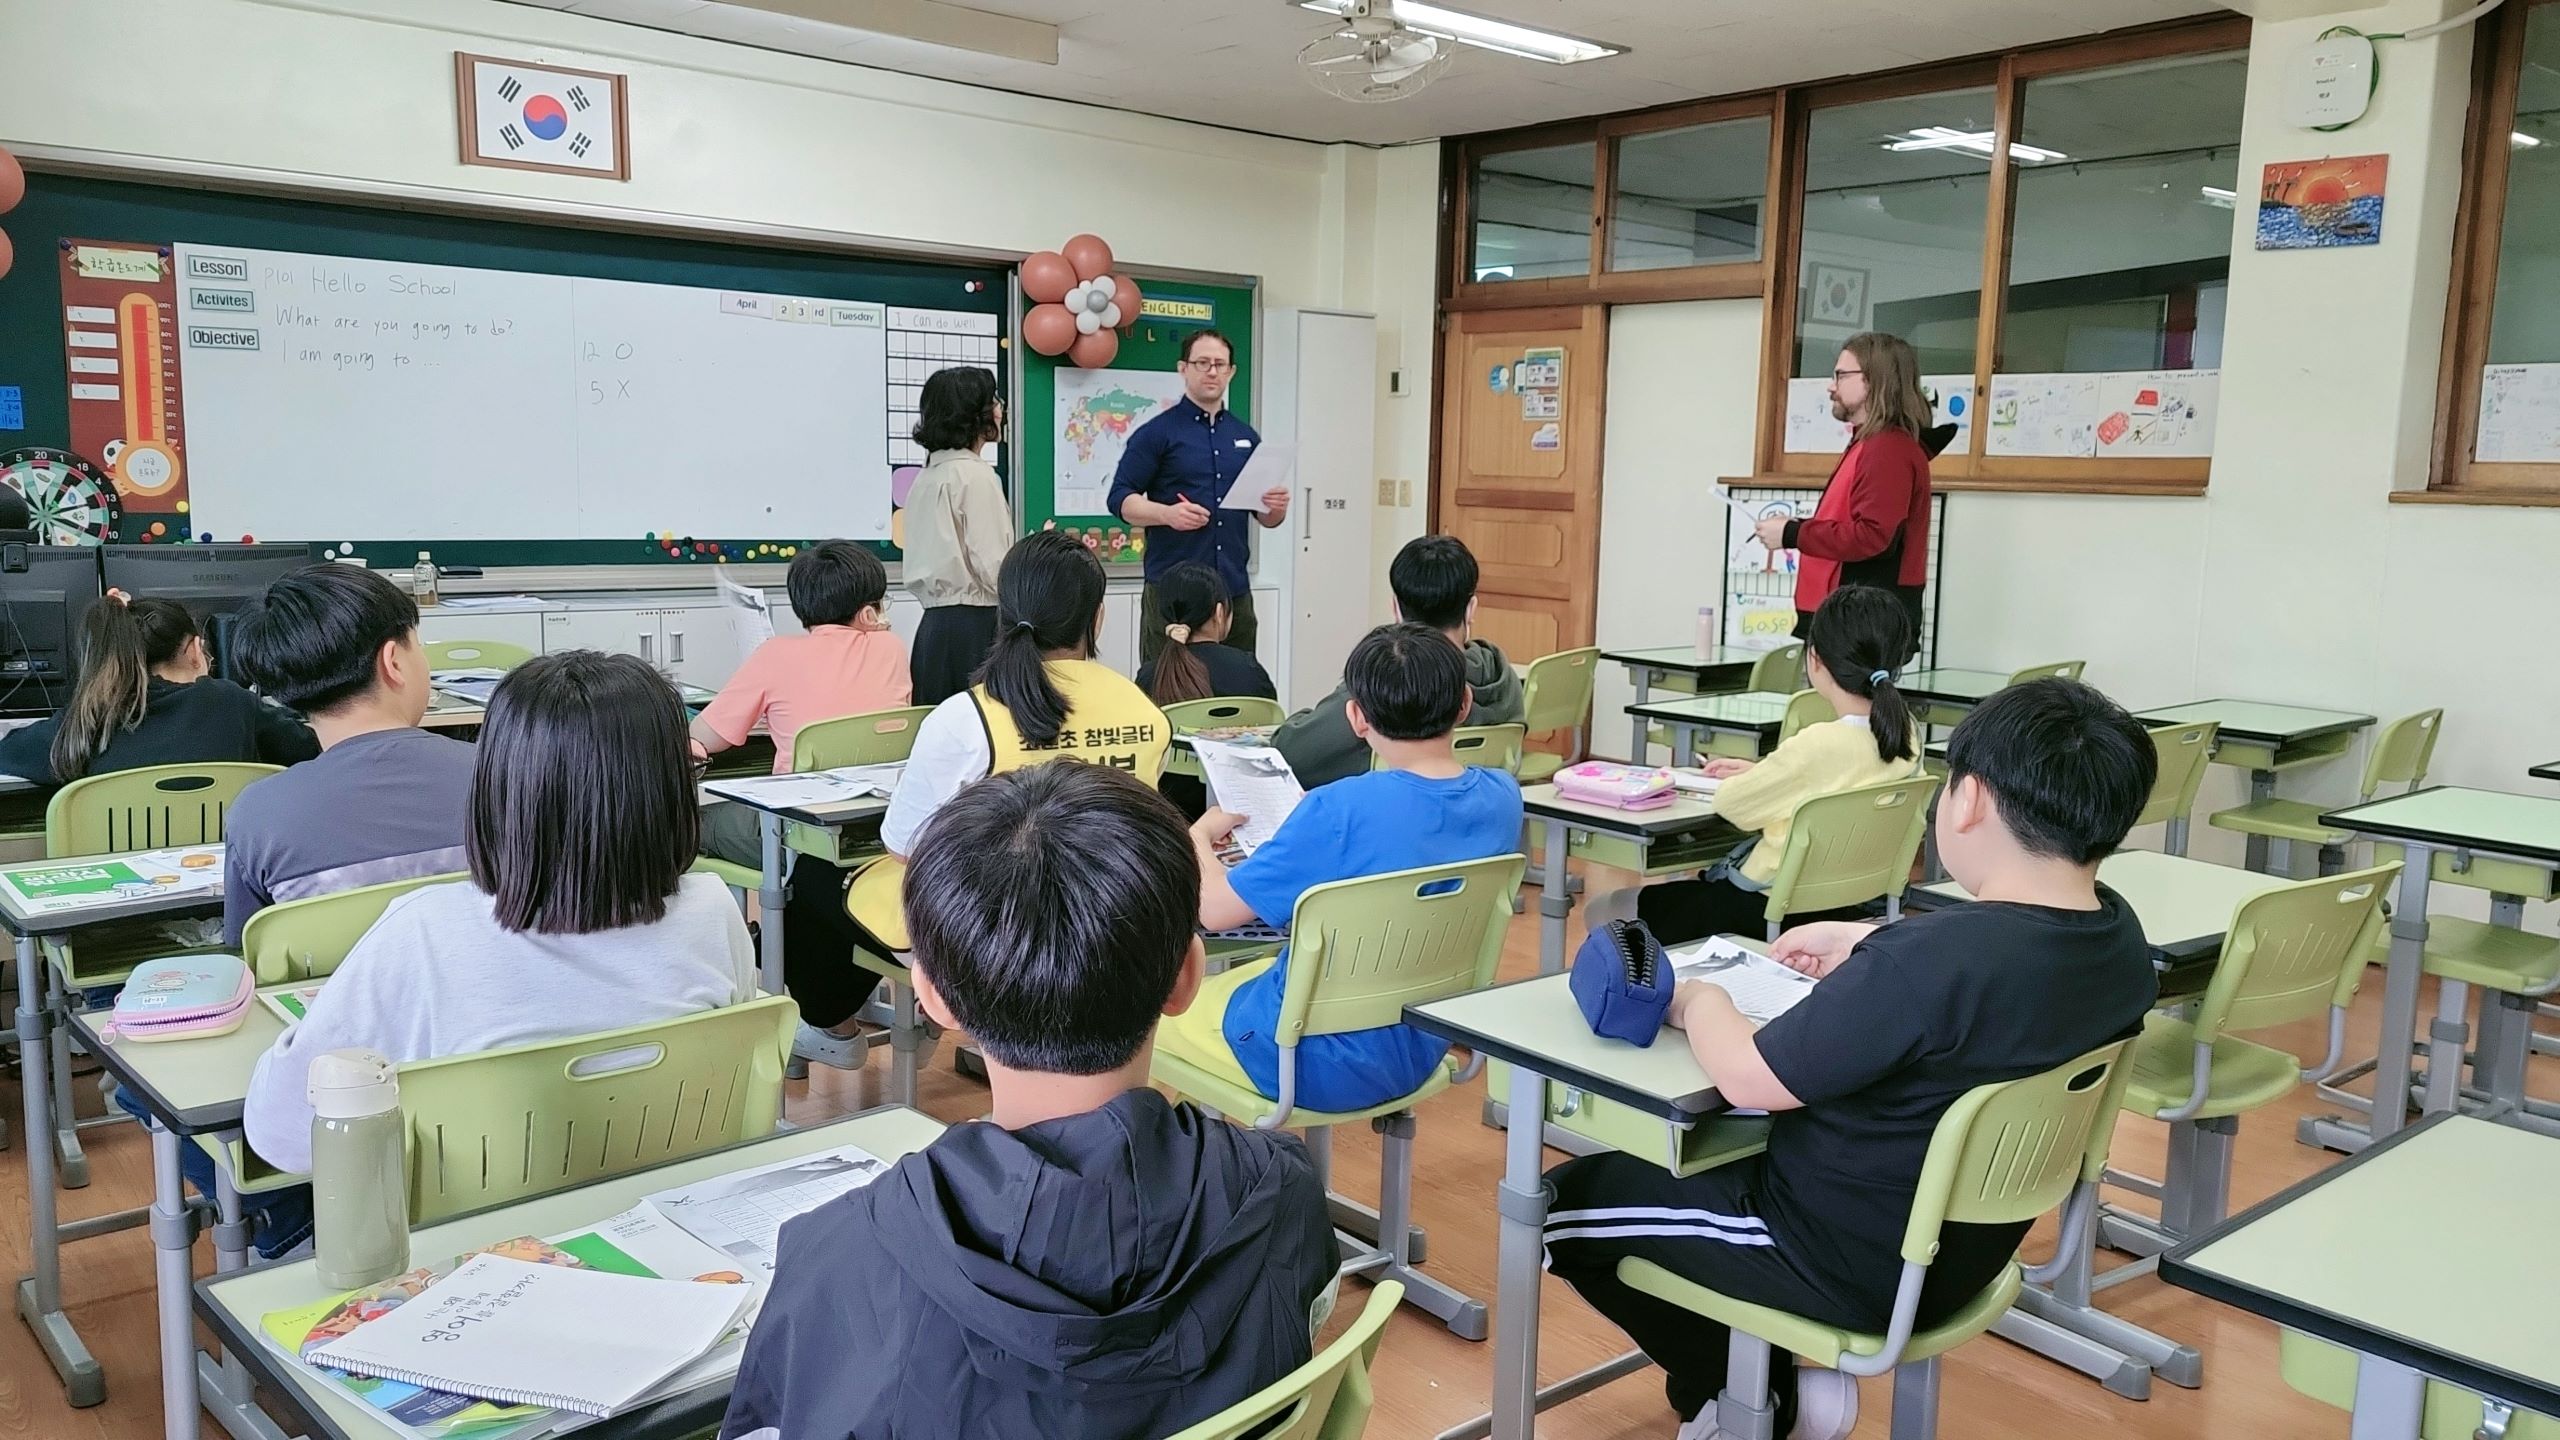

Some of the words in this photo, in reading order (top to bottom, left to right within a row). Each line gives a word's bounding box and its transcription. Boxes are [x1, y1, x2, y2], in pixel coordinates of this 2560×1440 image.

[91, 257, 146, 274] 학급온도계
[193, 259, 243, 276] Lesson
[312, 266, 367, 294] Hello
[388, 274, 457, 296] School
[197, 293, 249, 308] Activites
[736, 298, 757, 310] April
[781, 305, 787, 315] 2
[797, 307, 804, 316] 3
[814, 307, 825, 317] rd
[276, 304, 321, 328] What
[334, 317, 360, 329] are
[375, 321, 399, 337] you
[412, 322, 451, 341] going
[464, 323, 478, 336] to
[490, 319, 515, 337] do?
[837, 311, 875, 323] Tuesday
[895, 312, 903, 327] I
[953, 318, 976, 329] well
[193, 329, 255, 346] Objective
[583, 341, 600, 362] 12
[300, 350, 322, 361] am
[333, 351, 374, 371] going
[393, 352, 410, 365] to
[591, 381, 604, 405] 5
[15, 453, 23, 462] 5
[34, 451, 48, 460] 20
[59, 455, 64, 463] 1
[77, 463, 89, 472] 18
[95, 477, 102, 486] 4
[105, 494, 117, 502] 13
[111, 511, 118, 519] 6
[108, 531, 119, 539] 10
[1084, 723, 1154, 748] 참빛글터
